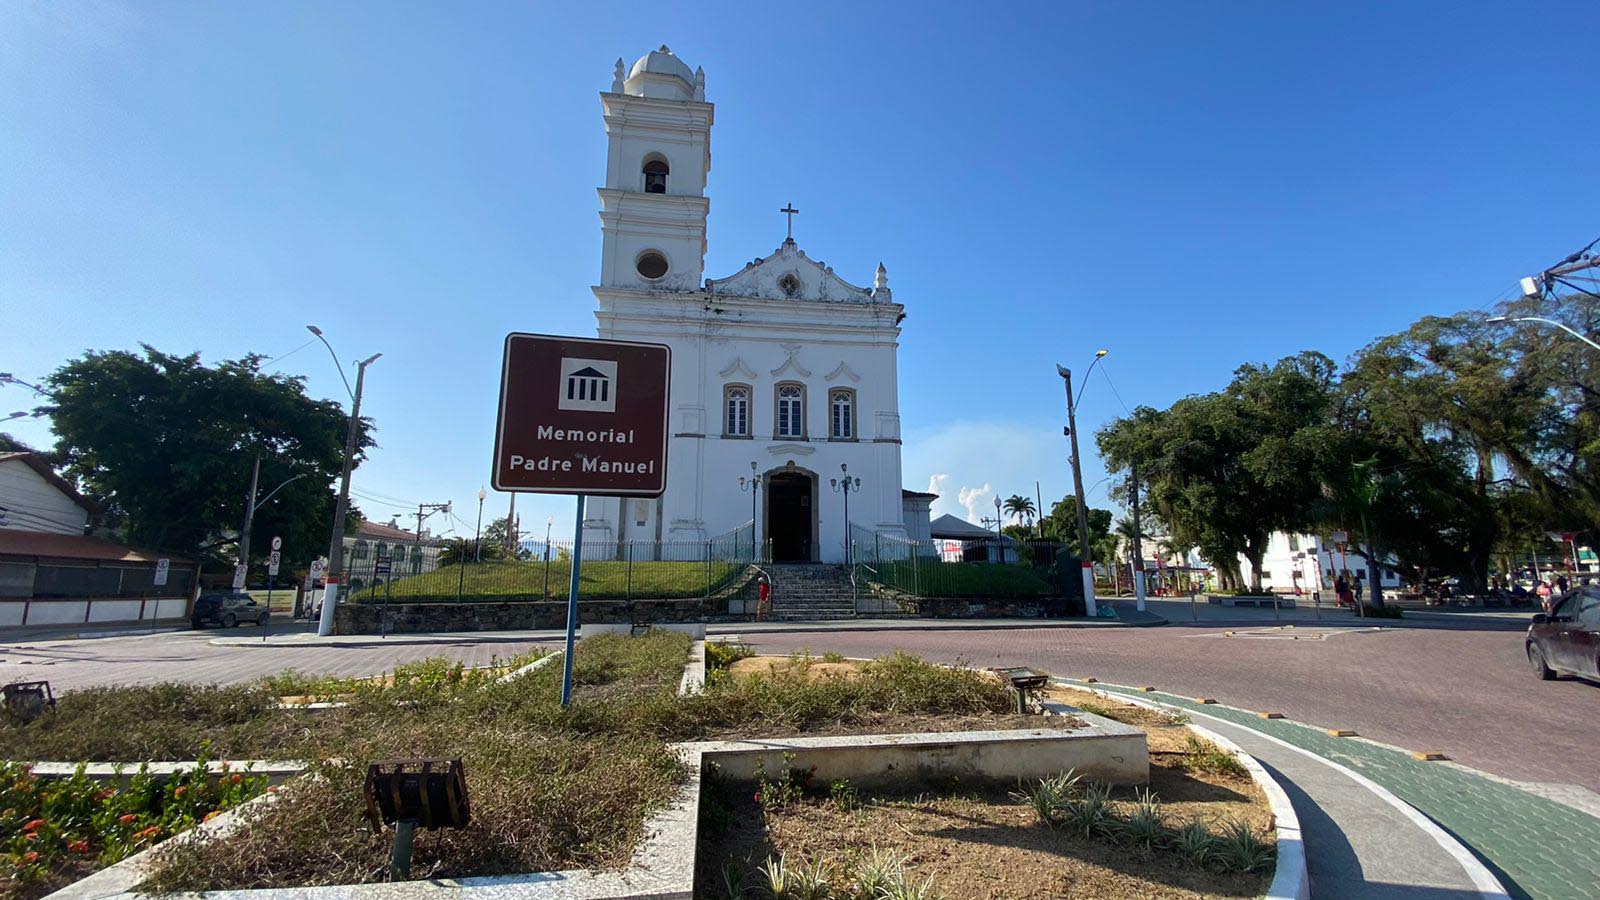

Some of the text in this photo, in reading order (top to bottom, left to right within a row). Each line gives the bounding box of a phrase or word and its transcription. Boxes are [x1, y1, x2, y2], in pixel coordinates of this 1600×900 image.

[537, 425, 634, 443] Memorial
[510, 455, 654, 474] Padre Manuel
